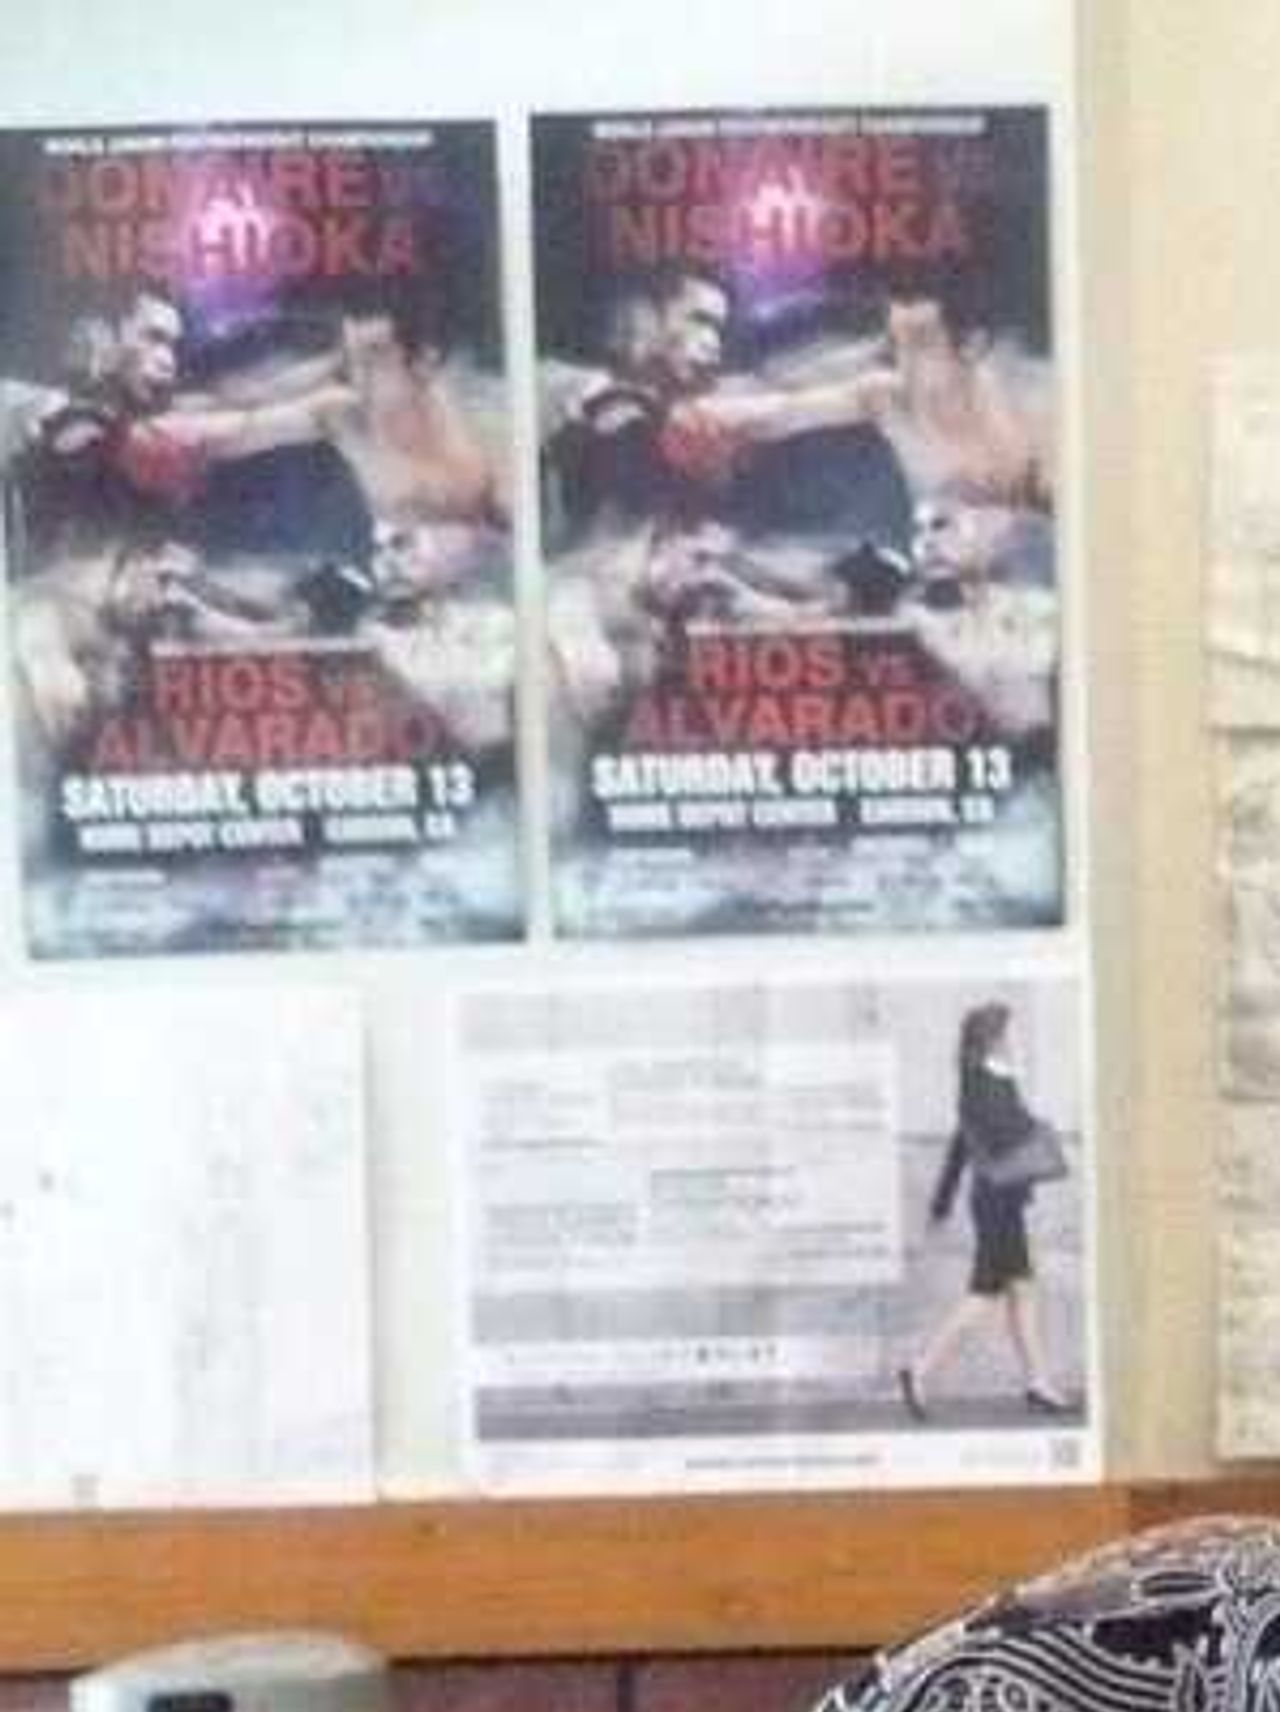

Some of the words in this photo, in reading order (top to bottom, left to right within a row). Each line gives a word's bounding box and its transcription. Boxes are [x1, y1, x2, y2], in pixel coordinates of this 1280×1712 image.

[156, 656, 310, 711] RIOS
[694, 634, 843, 689] RIOS
[627, 691, 976, 748] ALVARADO
[257, 765, 416, 811] OCTOBER
[428, 762, 474, 808] 13
[792, 747, 956, 792] OCTOBER
[966, 746, 1012, 789] 13
